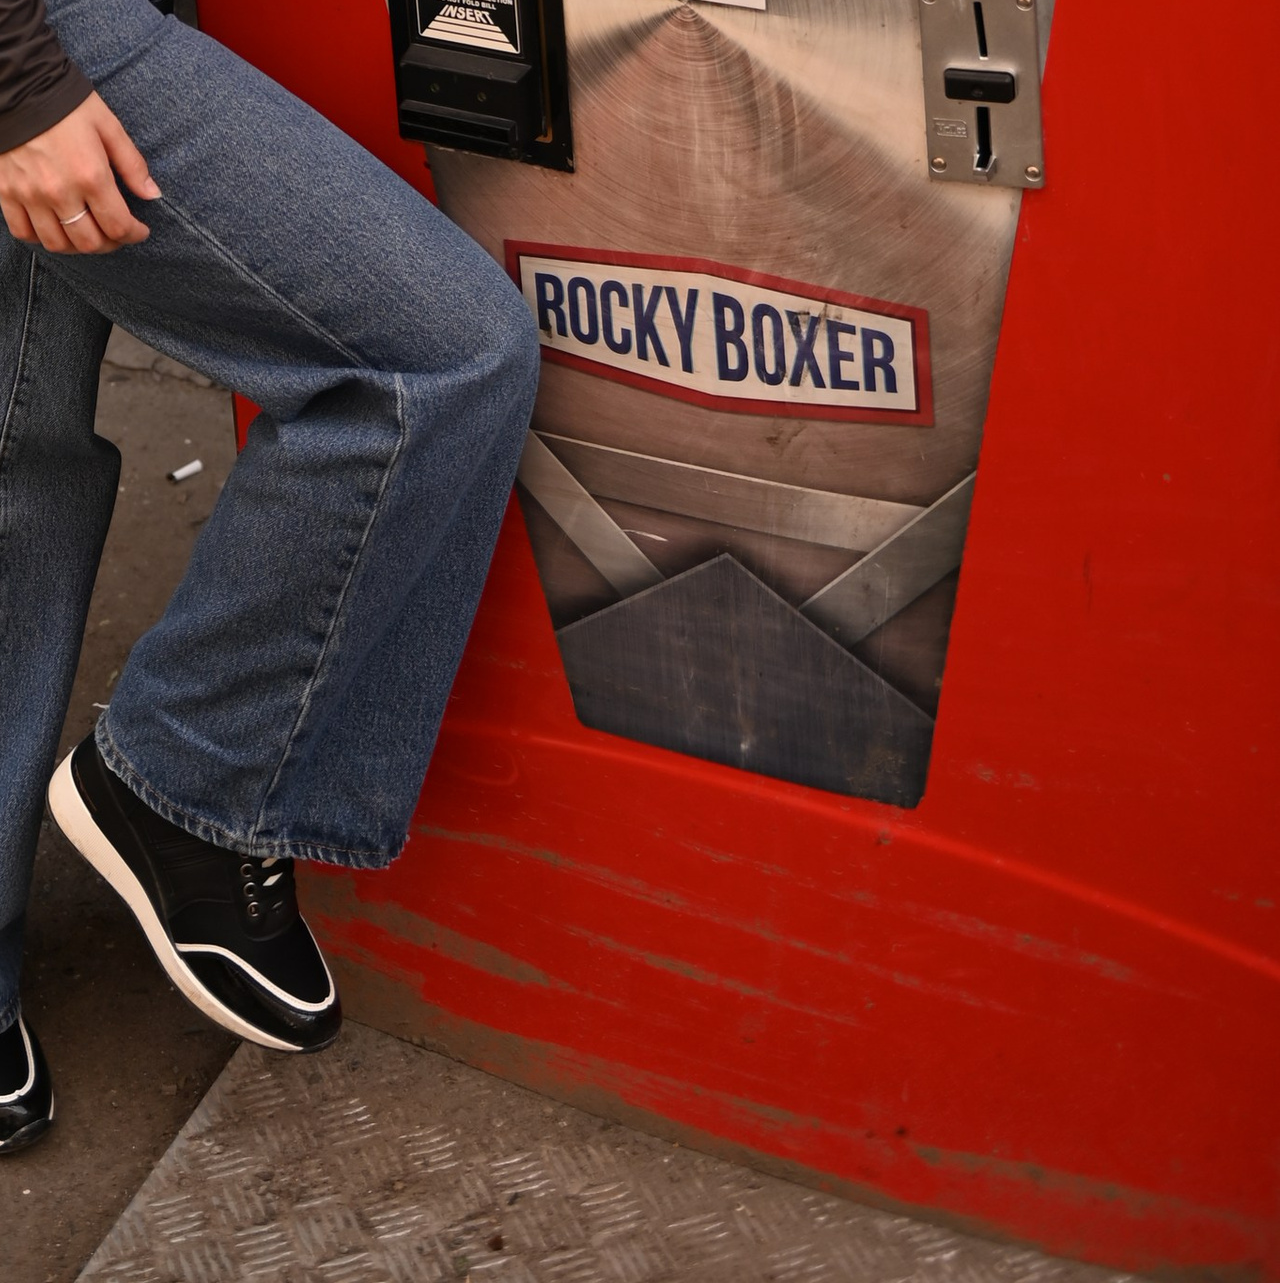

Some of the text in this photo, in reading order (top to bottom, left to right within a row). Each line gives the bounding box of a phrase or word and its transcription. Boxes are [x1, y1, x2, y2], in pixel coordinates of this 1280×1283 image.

[439, 4, 494, 25] INSERT
[481, 2, 497, 11] BILL
[534, 272, 900, 395] ROCKY BOXER
